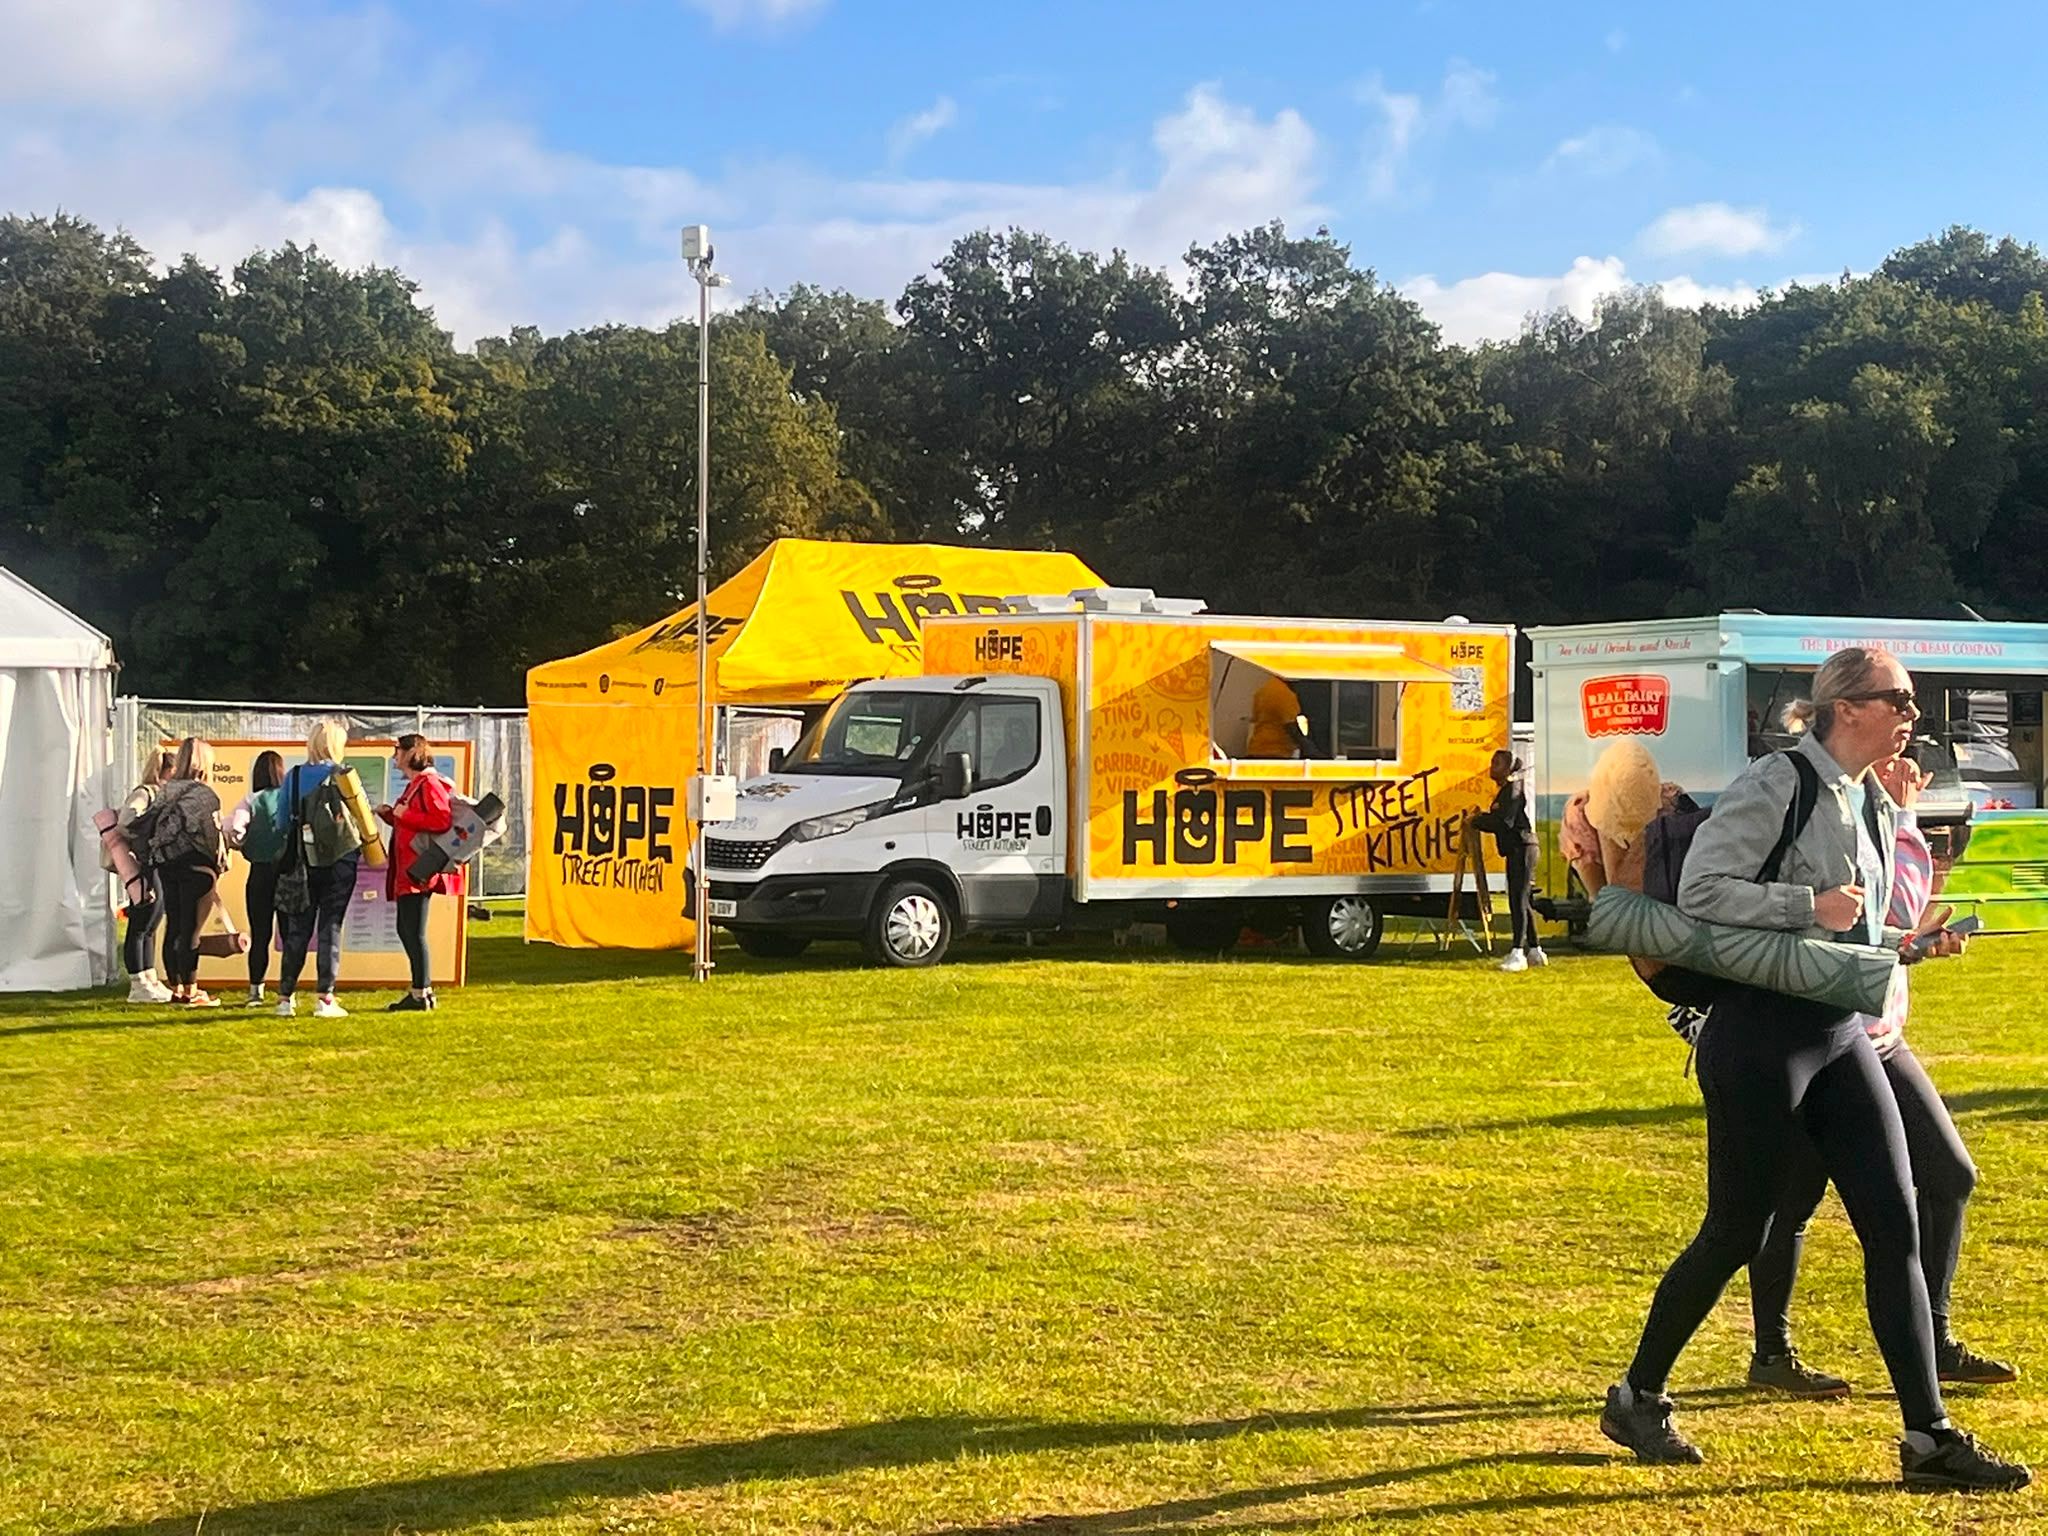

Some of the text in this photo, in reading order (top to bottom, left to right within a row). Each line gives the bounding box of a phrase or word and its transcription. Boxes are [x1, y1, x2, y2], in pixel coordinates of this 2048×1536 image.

[974, 632, 1024, 662] HOPE
[1450, 643, 1485, 660] HOPE
[1604, 640, 1636, 654] Drinks
[1640, 640, 1660, 652] and
[1800, 638, 1823, 652] THE
[1893, 641, 1911, 654] ICE
[1913, 641, 1950, 655] CREAM
[1953, 642, 2005, 657] COMPANY
[1588, 689, 1664, 707] REAL DAIRY
[1592, 702, 1660, 719] ICE CREAM
[1099, 702, 1142, 727] TING
[1094, 752, 1169, 781] CARIBBEAN
[1328, 766, 1440, 838] STREET
[553, 779, 675, 864] HOPE
[957, 810, 1032, 840] HOPE
[1122, 786, 1314, 866] HOPE
[562, 852, 664, 895] STREET KITCHEN
